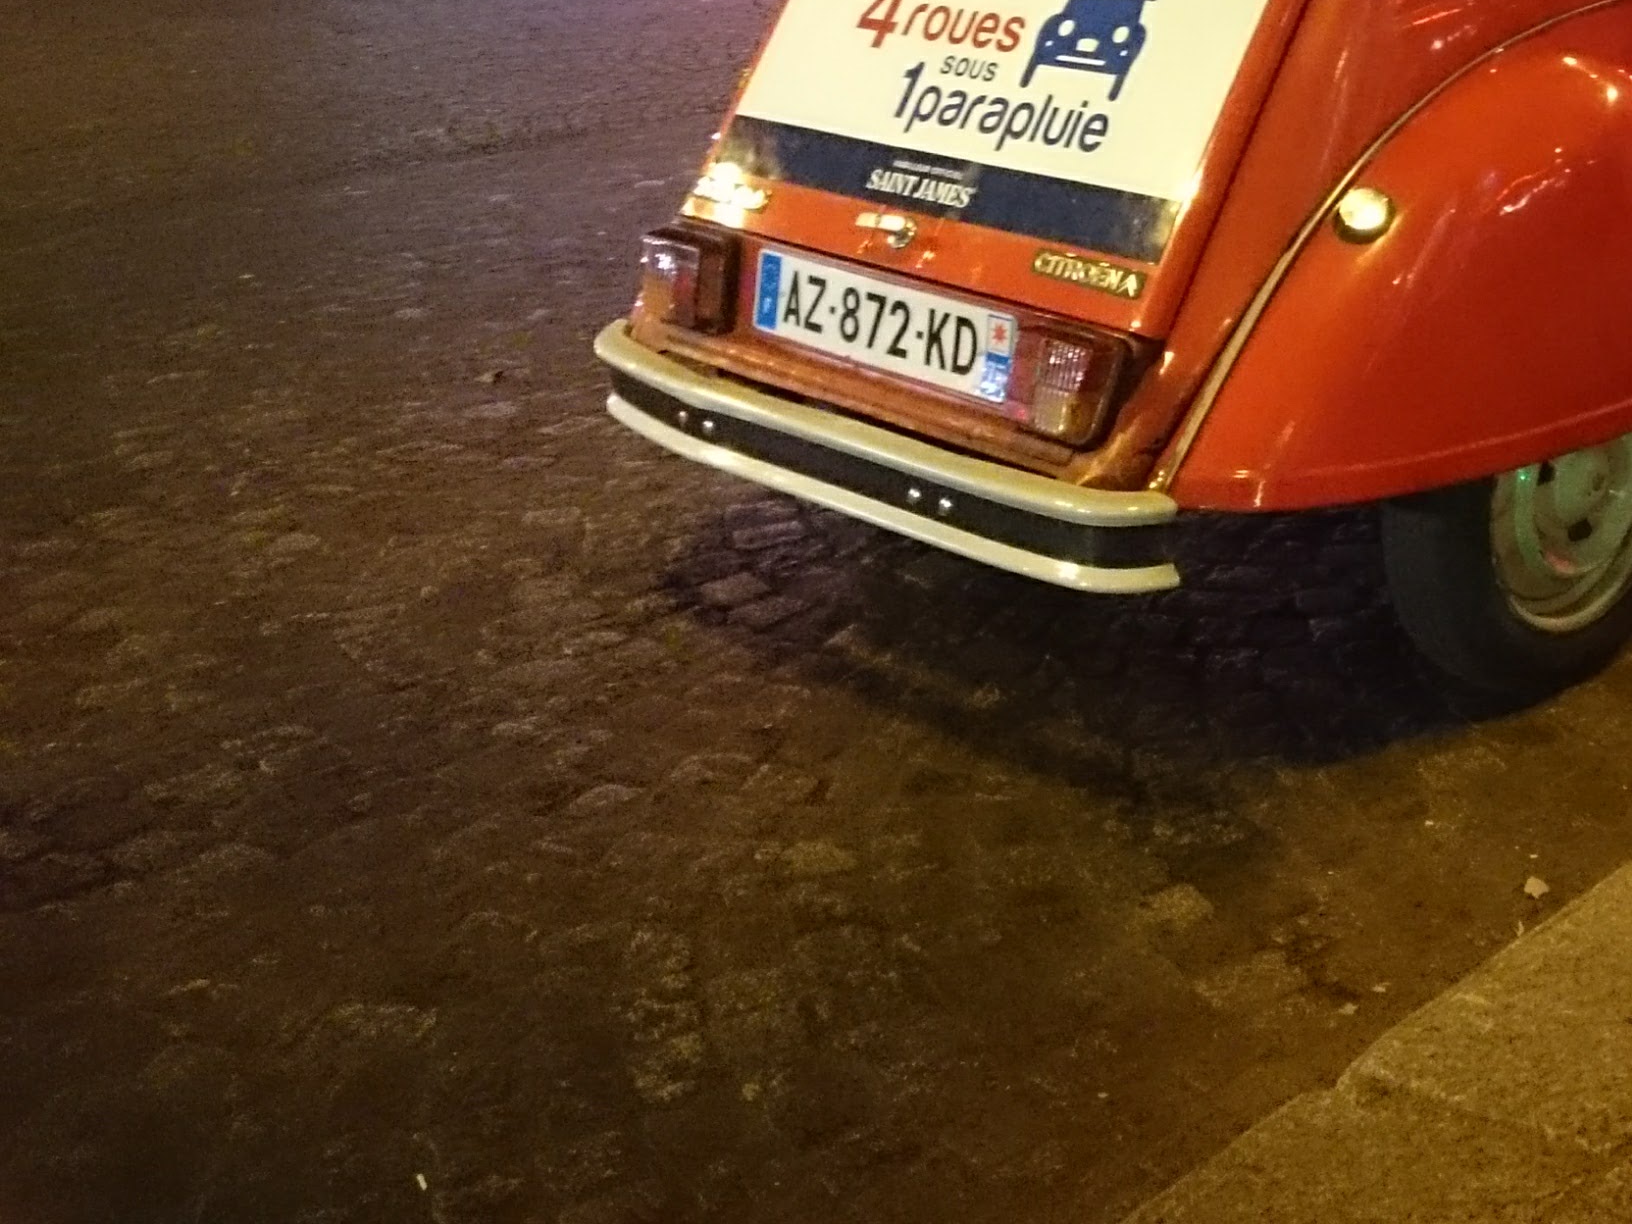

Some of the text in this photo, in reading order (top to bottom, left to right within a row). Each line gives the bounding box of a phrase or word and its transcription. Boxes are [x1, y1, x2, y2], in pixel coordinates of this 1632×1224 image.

[901, 2, 1026, 53] roues
[939, 54, 1000, 82] sous
[865, 168, 921, 197] SAINT
[912, 178, 979, 209] JAMES
